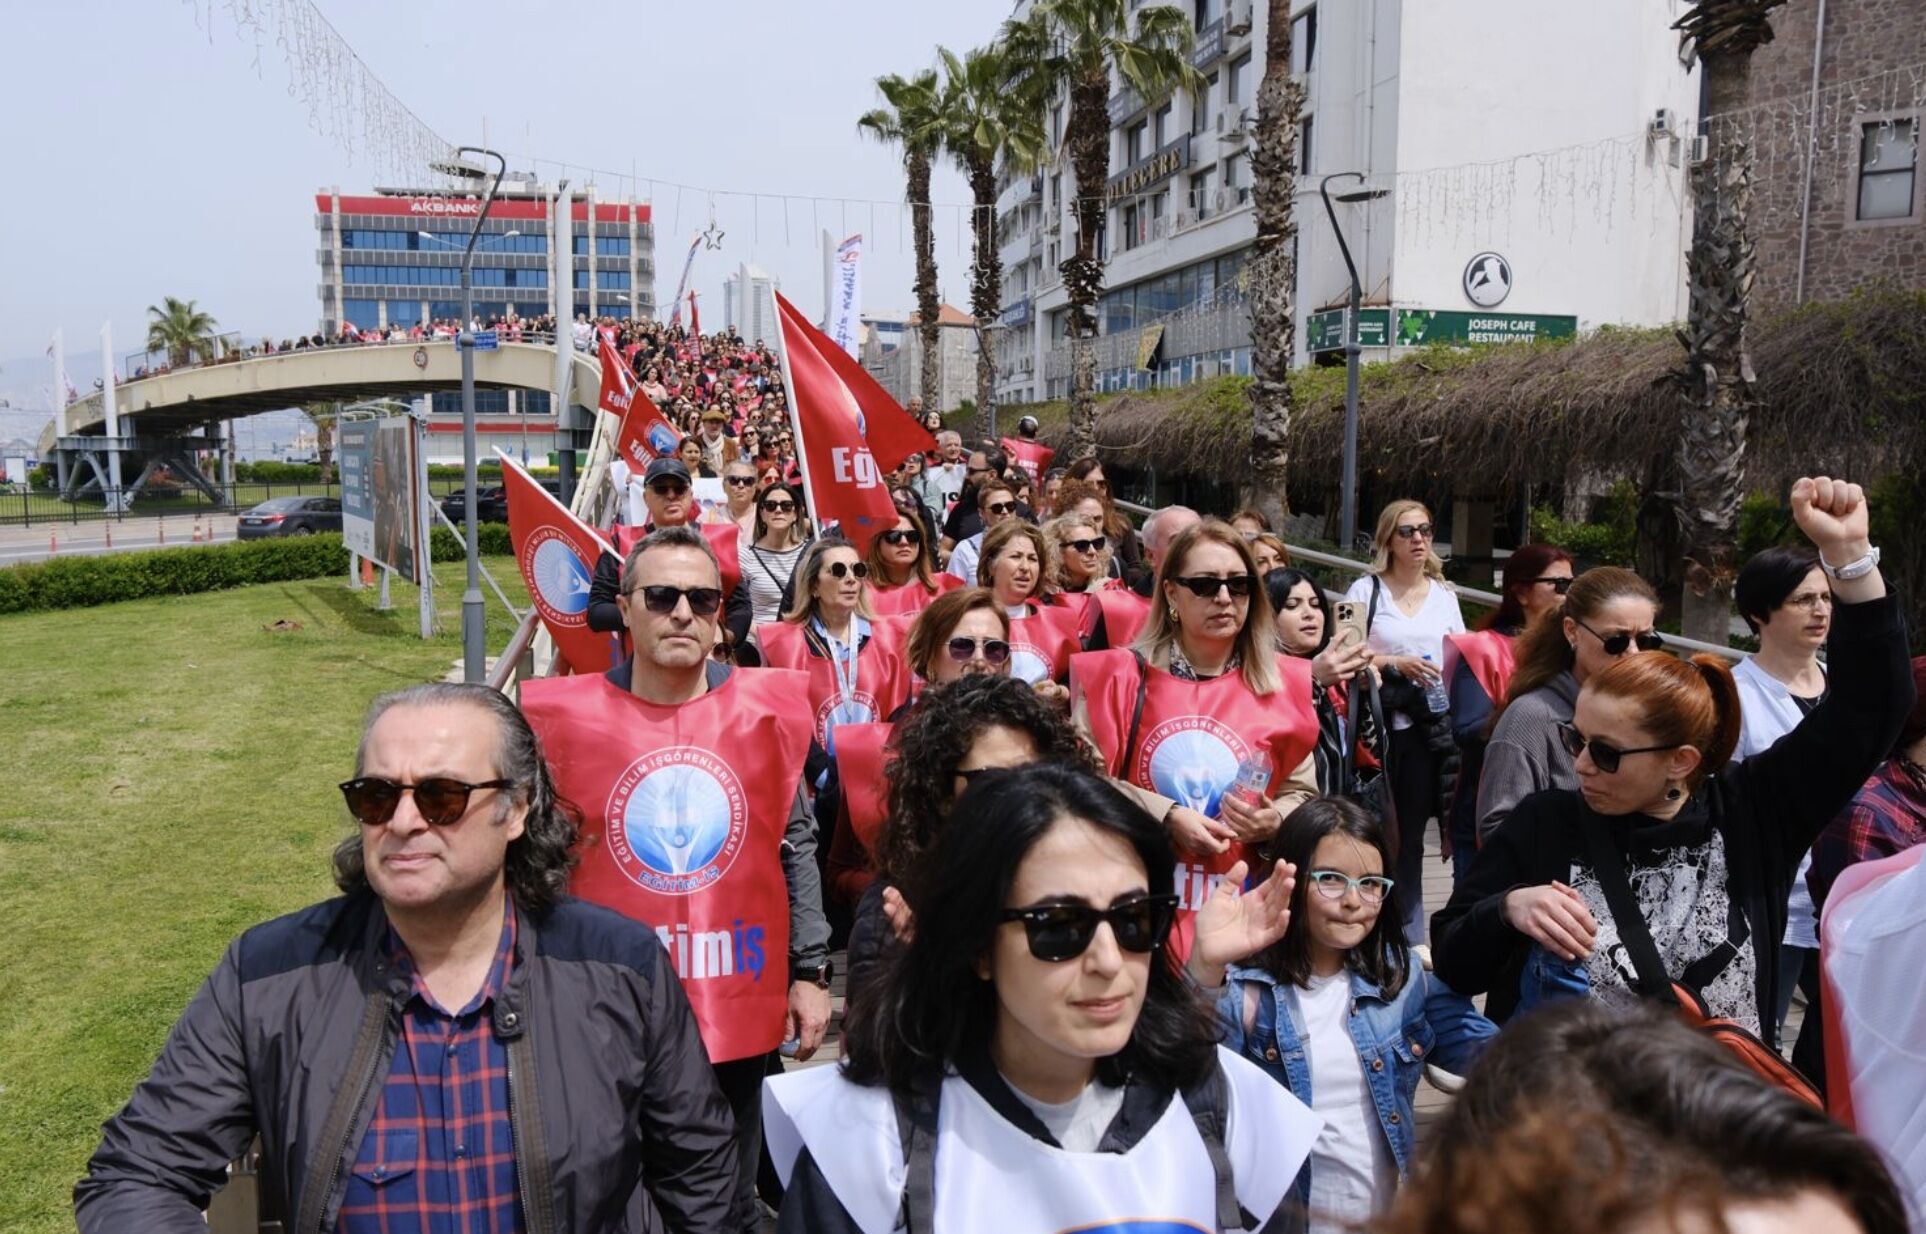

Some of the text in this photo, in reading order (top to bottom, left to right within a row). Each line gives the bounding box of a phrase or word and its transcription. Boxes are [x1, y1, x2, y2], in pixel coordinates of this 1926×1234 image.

[411, 202, 478, 213] AKBANK
[1468, 319, 1536, 331] JOSEPH CAFE
[612, 799, 624, 814] VE
[619, 763, 649, 795] BİLİM
